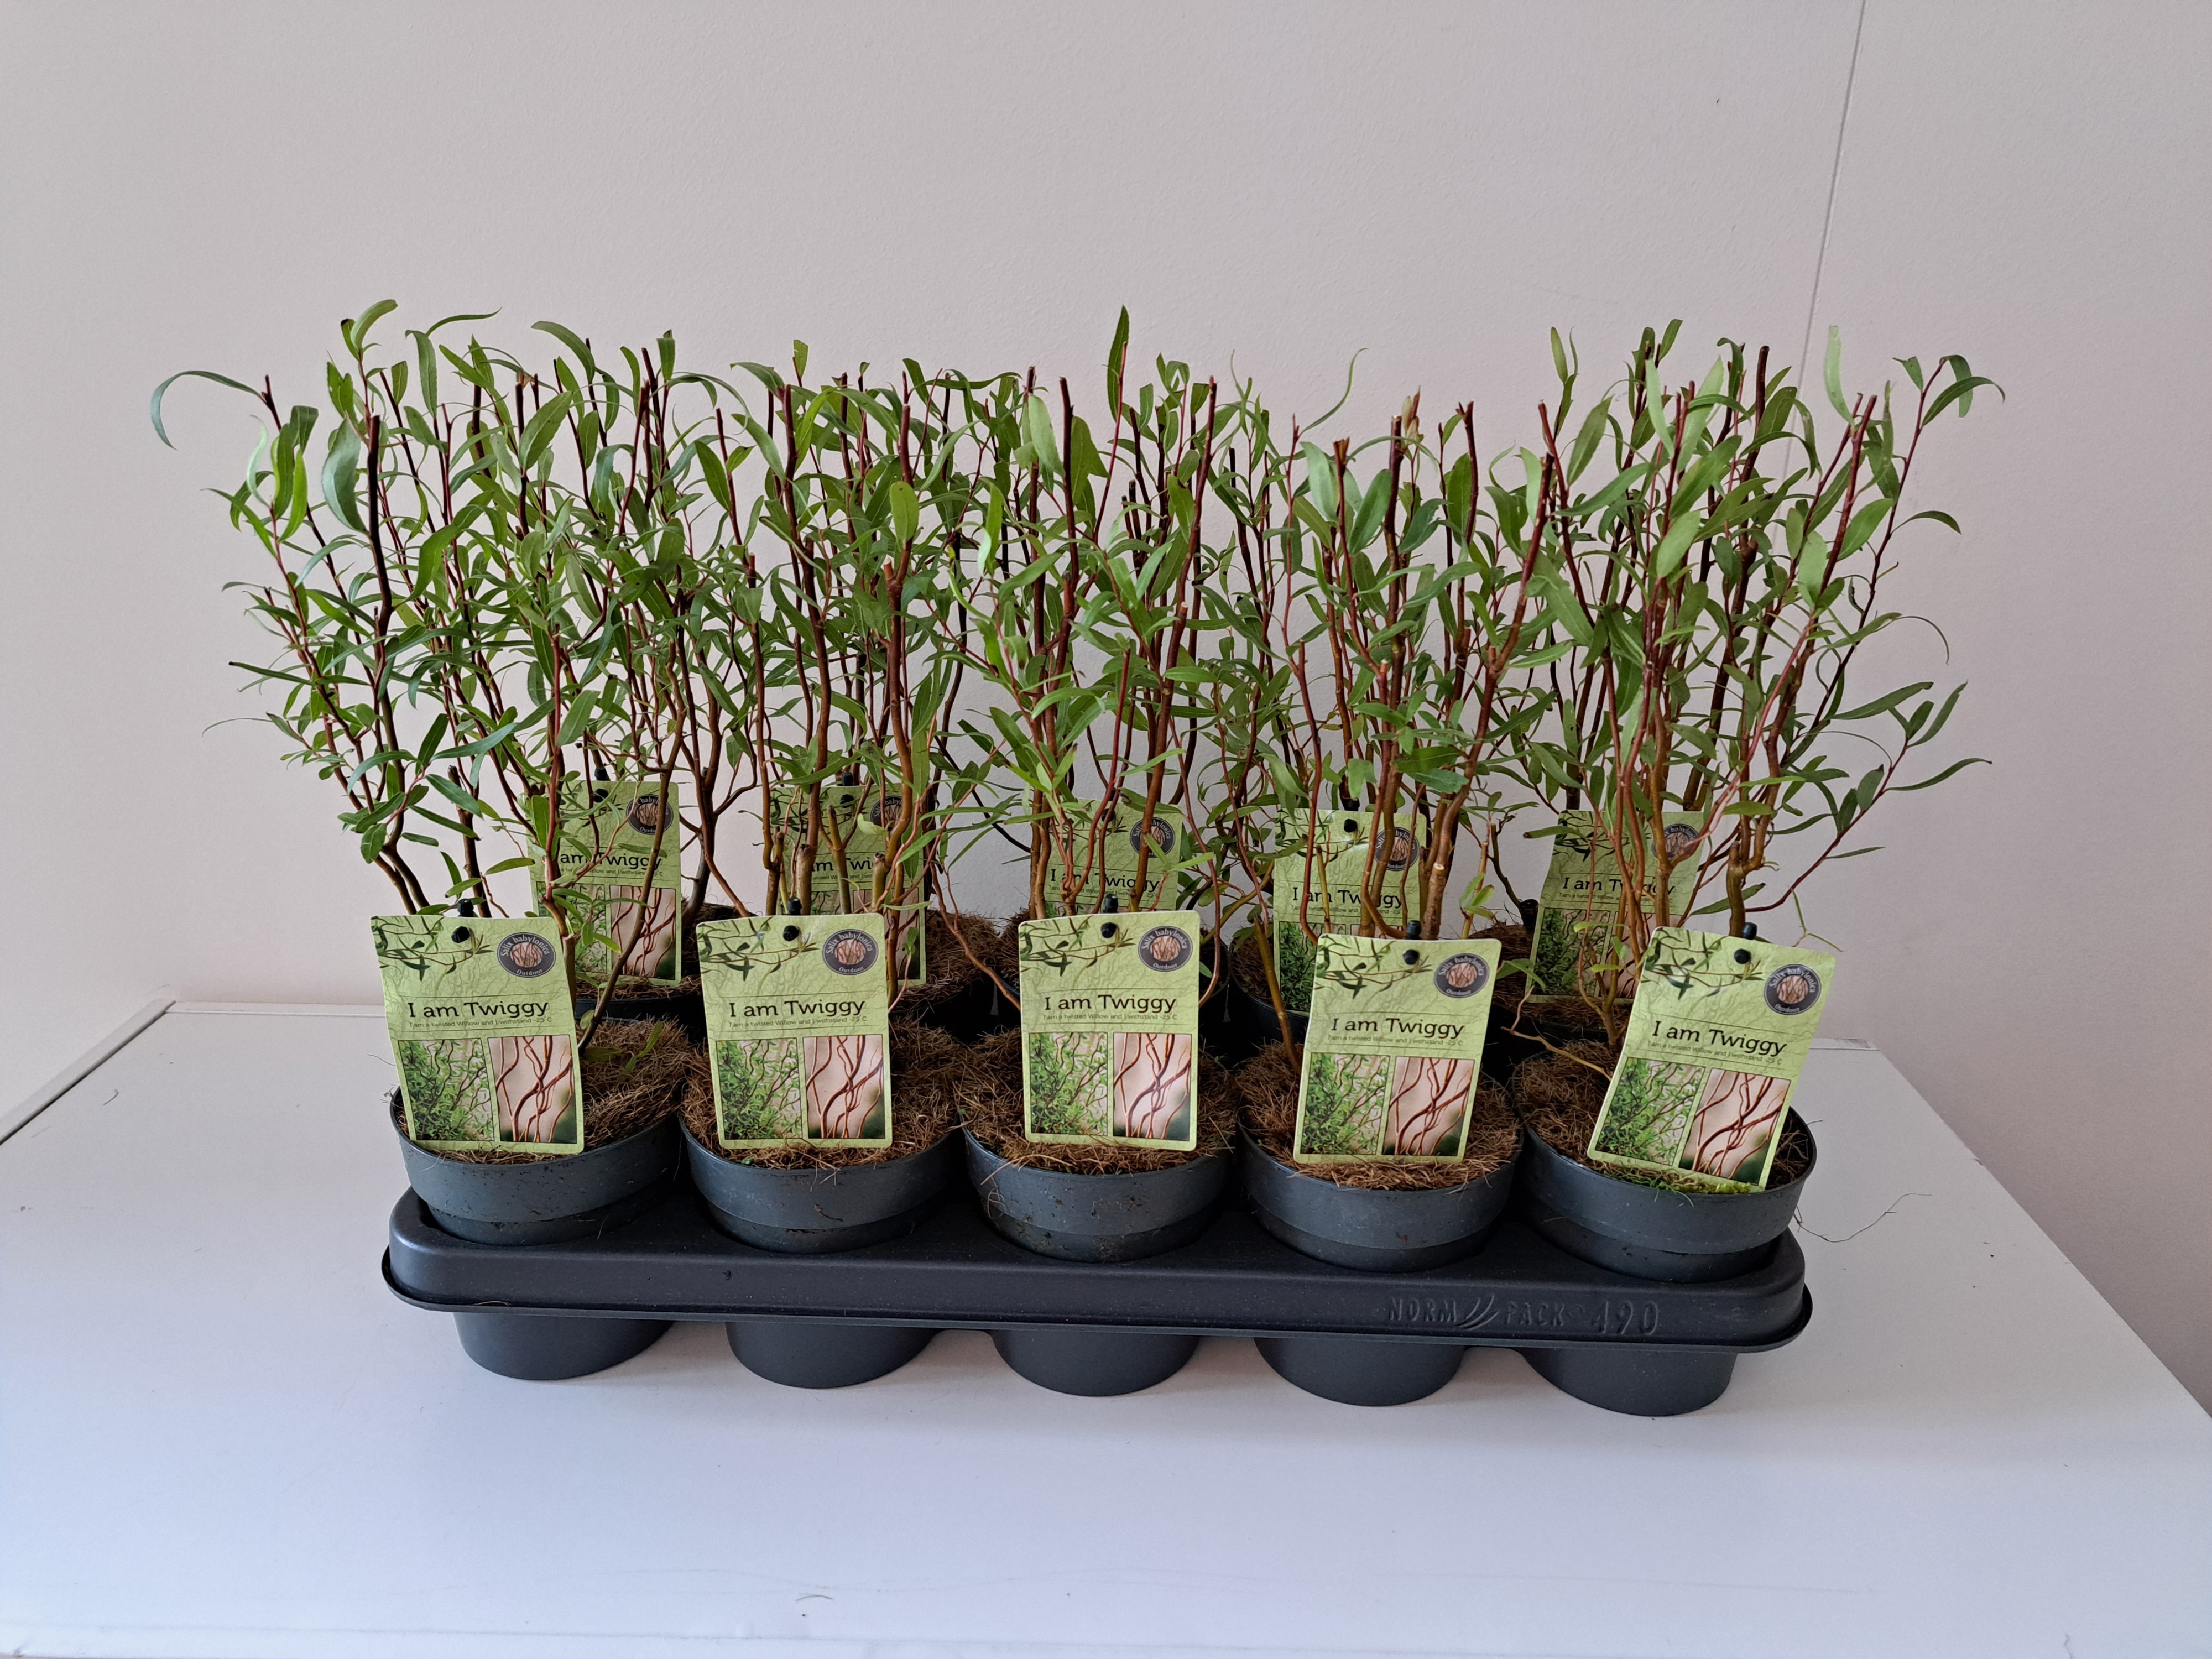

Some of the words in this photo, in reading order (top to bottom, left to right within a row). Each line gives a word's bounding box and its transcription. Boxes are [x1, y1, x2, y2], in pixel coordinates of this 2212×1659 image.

[560, 853, 588, 864] am
[812, 862, 833, 872] m
[1051, 869, 1056, 881] I
[1563, 877, 1570, 889] I
[1574, 879, 1602, 891] am
[1293, 887, 1298, 901] I
[1338, 890, 1402, 909] Twgy
[500, 941, 514, 957] Salix
[512, 935, 550, 954] babylonica
[825, 938, 839, 954] Salix
[838, 931, 873, 951] babylonica
[1141, 934, 1155, 950] Salix
[1155, 928, 1187, 949] babylonica
[1768, 972, 1786, 988] Salix
[1787, 967, 1818, 993] babylonica
[408, 1003, 416, 1018] I
[423, 1006, 459, 1018] am
[463, 1001, 549, 1018] Twiggy
[729, 1003, 737, 1018] I
[744, 1004, 779, 1017] am
[784, 999, 865, 1017] Twiggy
[1045, 997, 1051, 1010] I
[1058, 998, 1092, 1009] am
[1098, 994, 1176, 1014] Twiggy
[1331, 1018, 1339, 1031] I
[1344, 1020, 1378, 1032] am
[1386, 1018, 1465, 1040] Twiggy
[1652, 1021, 1662, 1036] I
[1666, 1027, 1700, 1042] am
[1709, 1029, 1787, 1057] Twiggy
[1731, 1053, 1762, 1061] withstand
[1389, 1297, 1458, 1323] NORM
